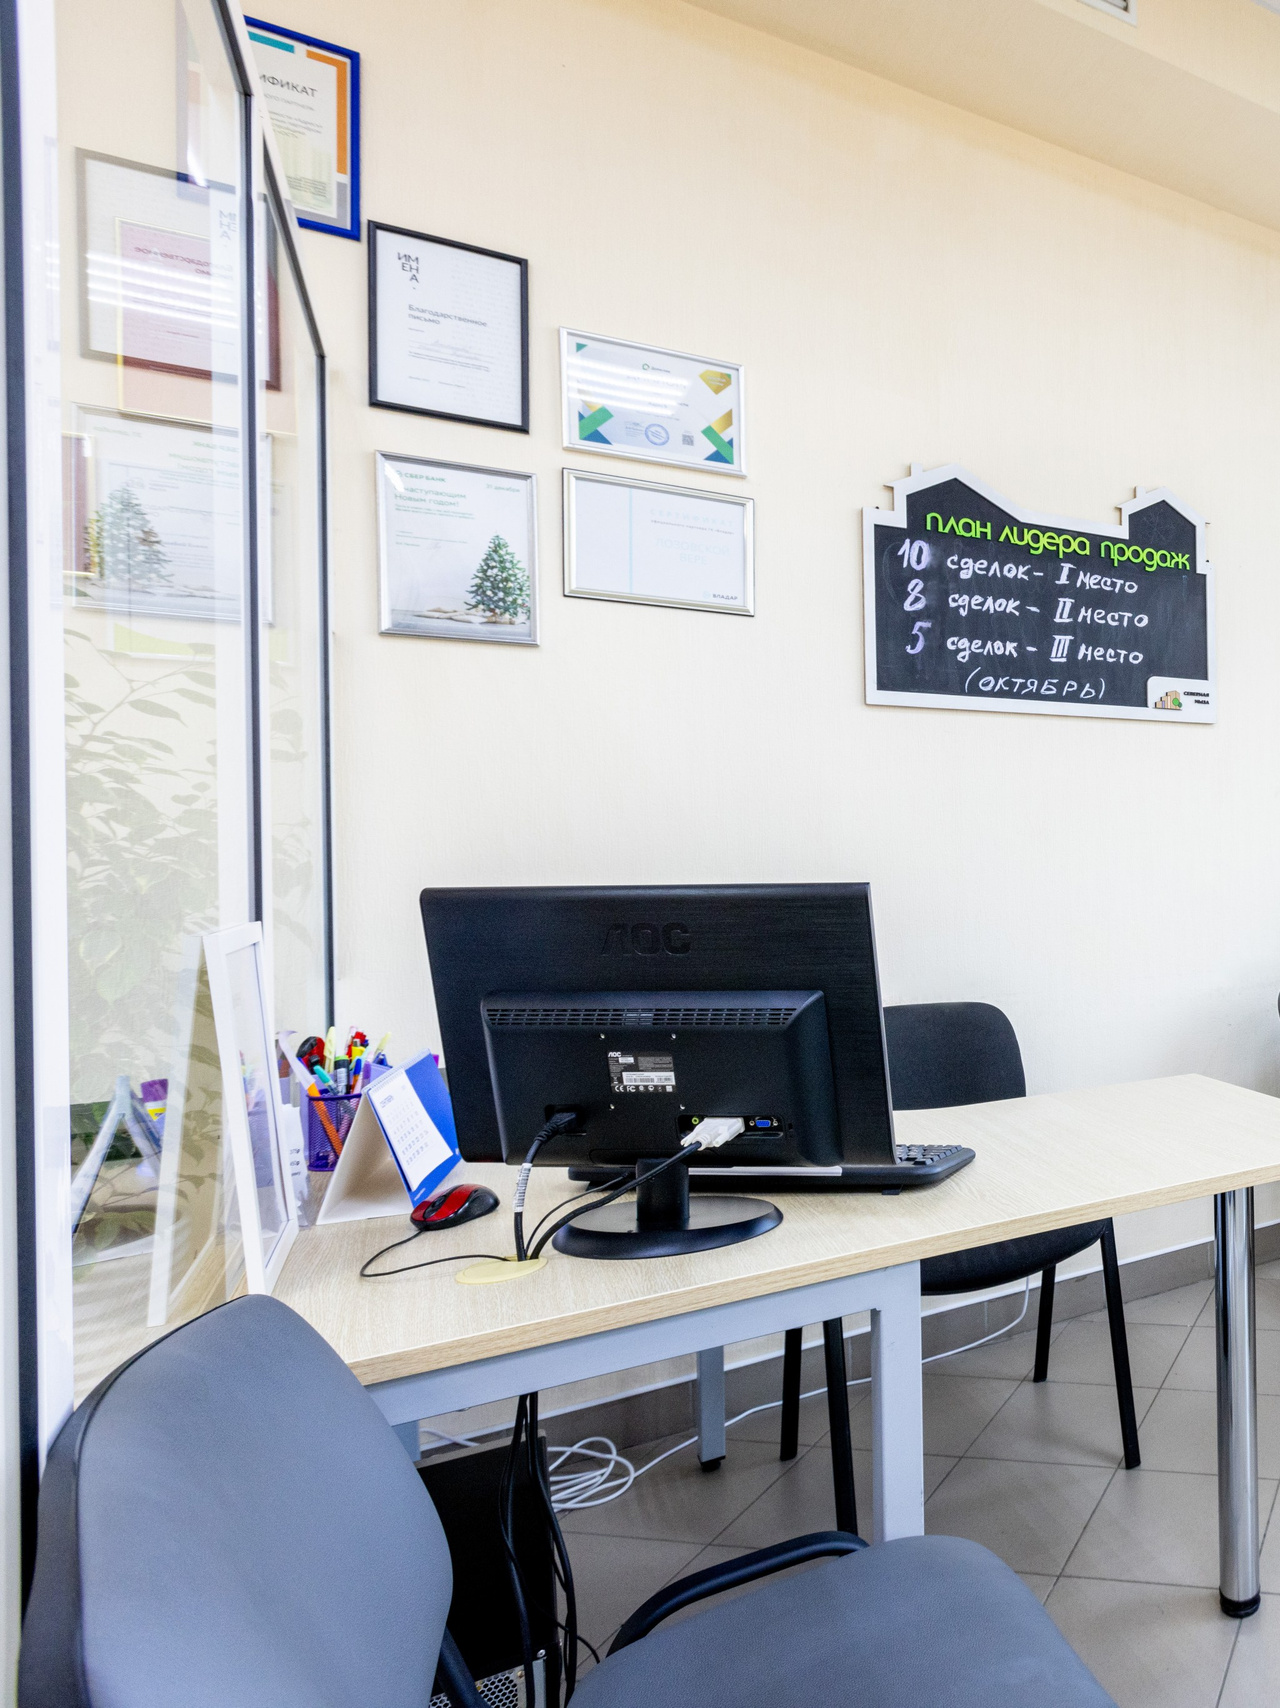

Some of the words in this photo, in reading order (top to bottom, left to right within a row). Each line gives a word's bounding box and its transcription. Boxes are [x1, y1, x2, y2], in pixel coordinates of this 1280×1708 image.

[259, 73, 318, 98] ИФИКАТ
[408, 303, 488, 327] Благодарственное
[408, 313, 441, 325] письмо
[394, 493, 427, 503] Новым
[897, 538, 931, 571] 10
[903, 578, 927, 611] 8
[905, 620, 932, 655] 5
[600, 921, 692, 956] AOC
